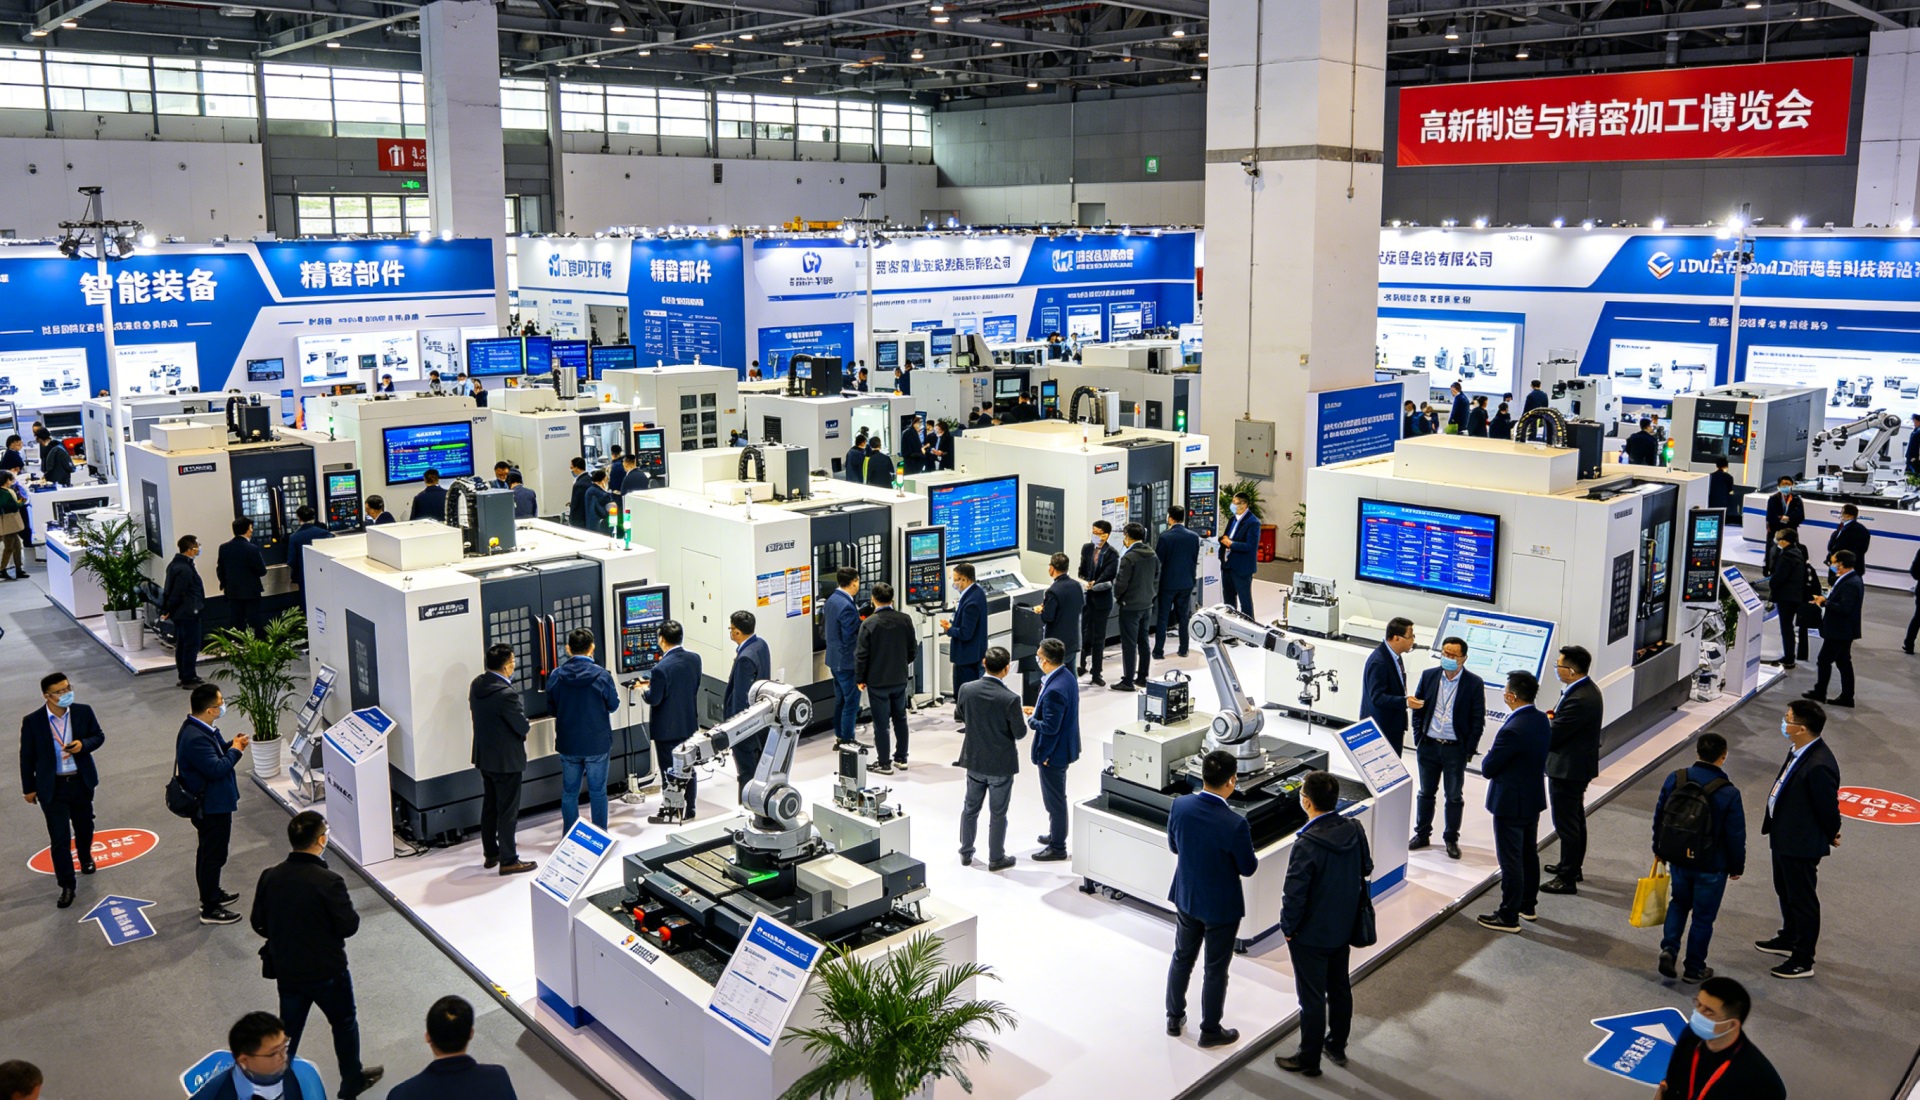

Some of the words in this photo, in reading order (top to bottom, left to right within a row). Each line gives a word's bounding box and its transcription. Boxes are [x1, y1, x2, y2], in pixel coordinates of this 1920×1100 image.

[1419, 88, 1815, 144] 高新制造与精密加工博览会
[79, 268, 218, 306] 智能装备
[299, 259, 406, 289] 精密部件
